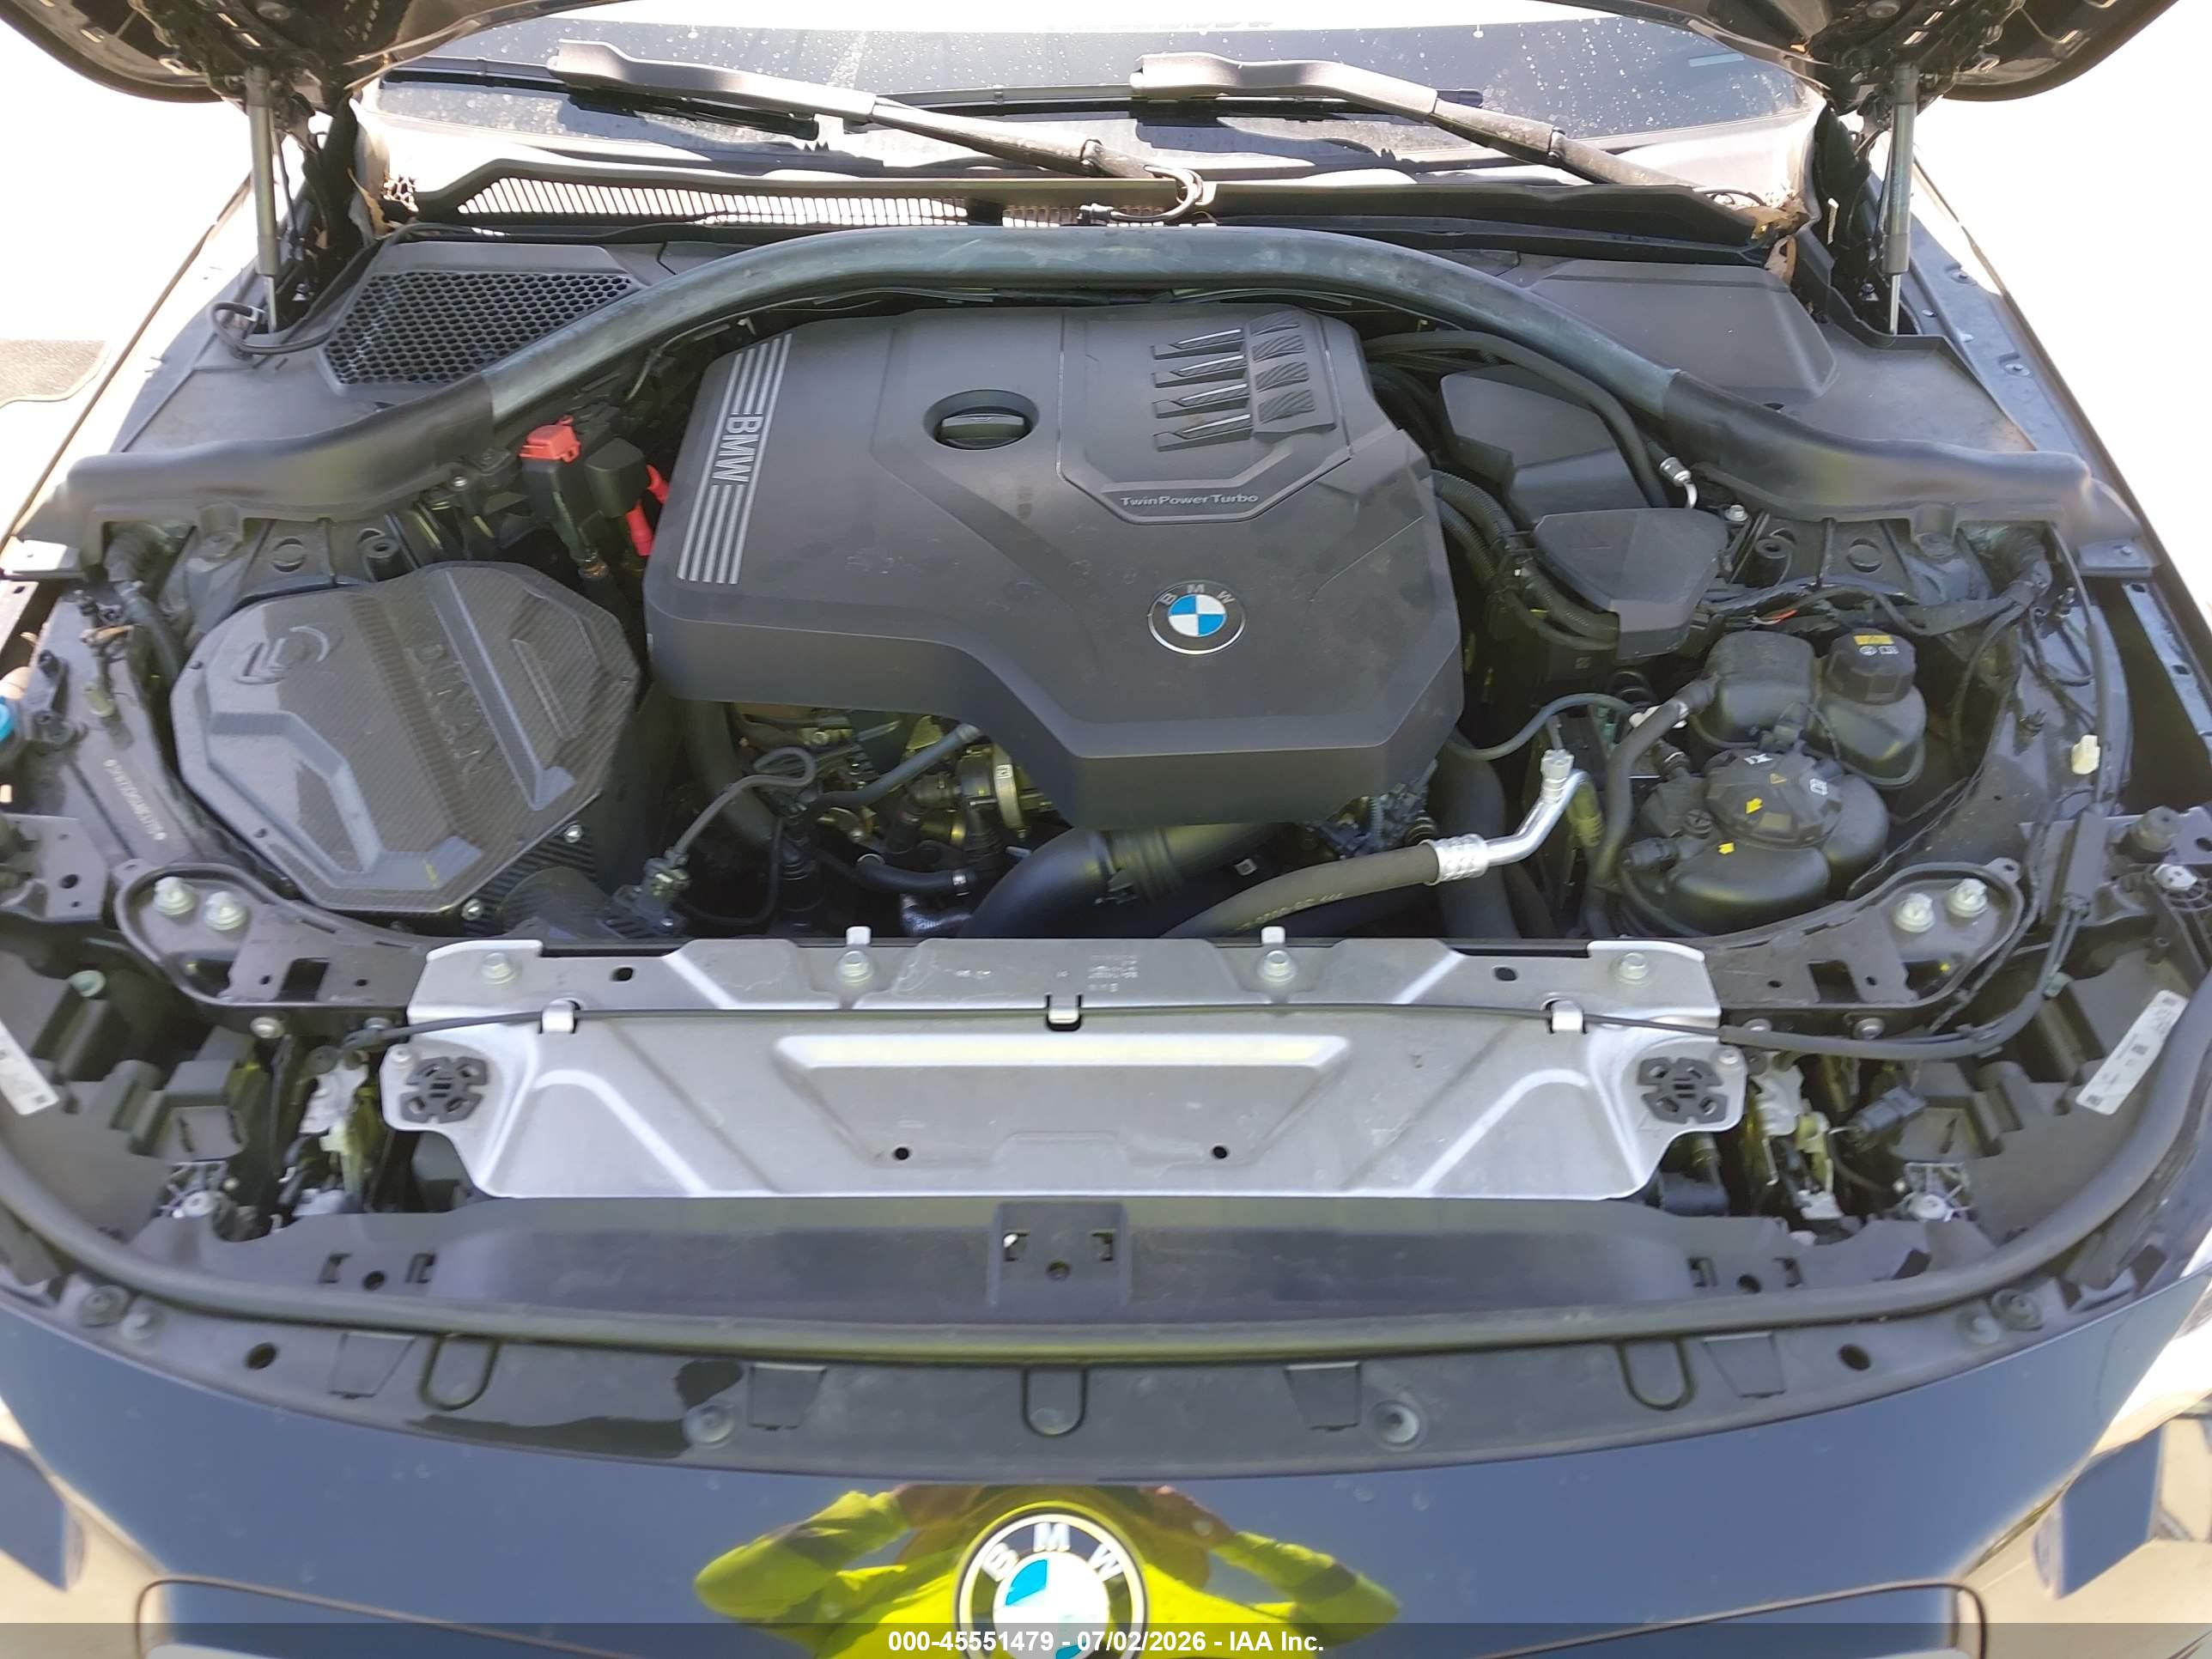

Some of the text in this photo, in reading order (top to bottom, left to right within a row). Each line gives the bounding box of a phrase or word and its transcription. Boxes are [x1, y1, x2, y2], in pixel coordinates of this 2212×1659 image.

[711, 416, 764, 483] BMW
[1210, 493, 1260, 504] Turbo
[1159, 583, 1237, 606] BMW
[981, 1520, 1125, 1583] BMW
